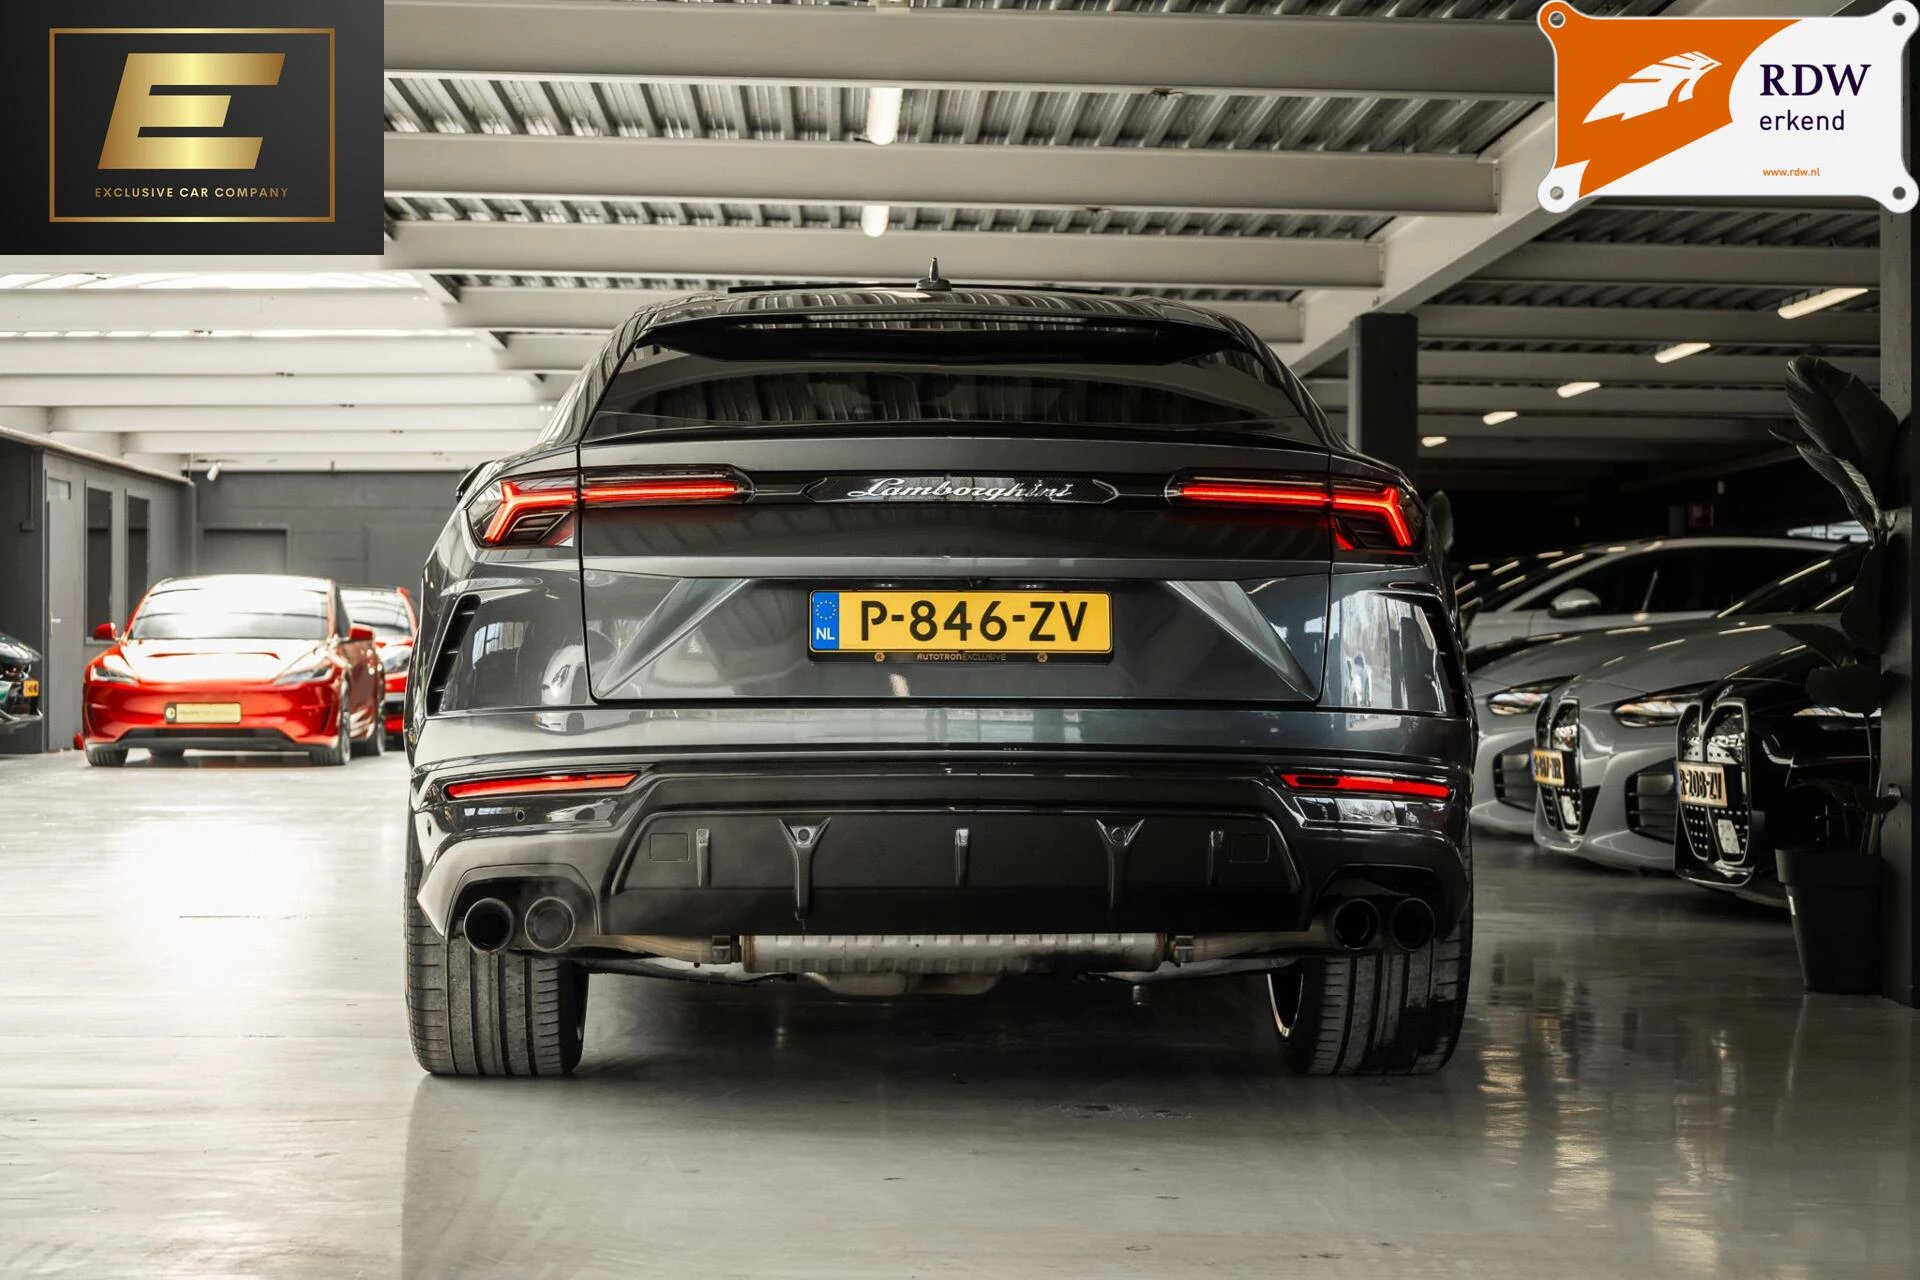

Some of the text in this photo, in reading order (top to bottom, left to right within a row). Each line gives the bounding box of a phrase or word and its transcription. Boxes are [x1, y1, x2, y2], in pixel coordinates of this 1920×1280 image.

[847, 478, 1073, 500] Lamborghini
[860, 600, 1088, 642] P-846-ZV
[816, 628, 835, 640] NL
